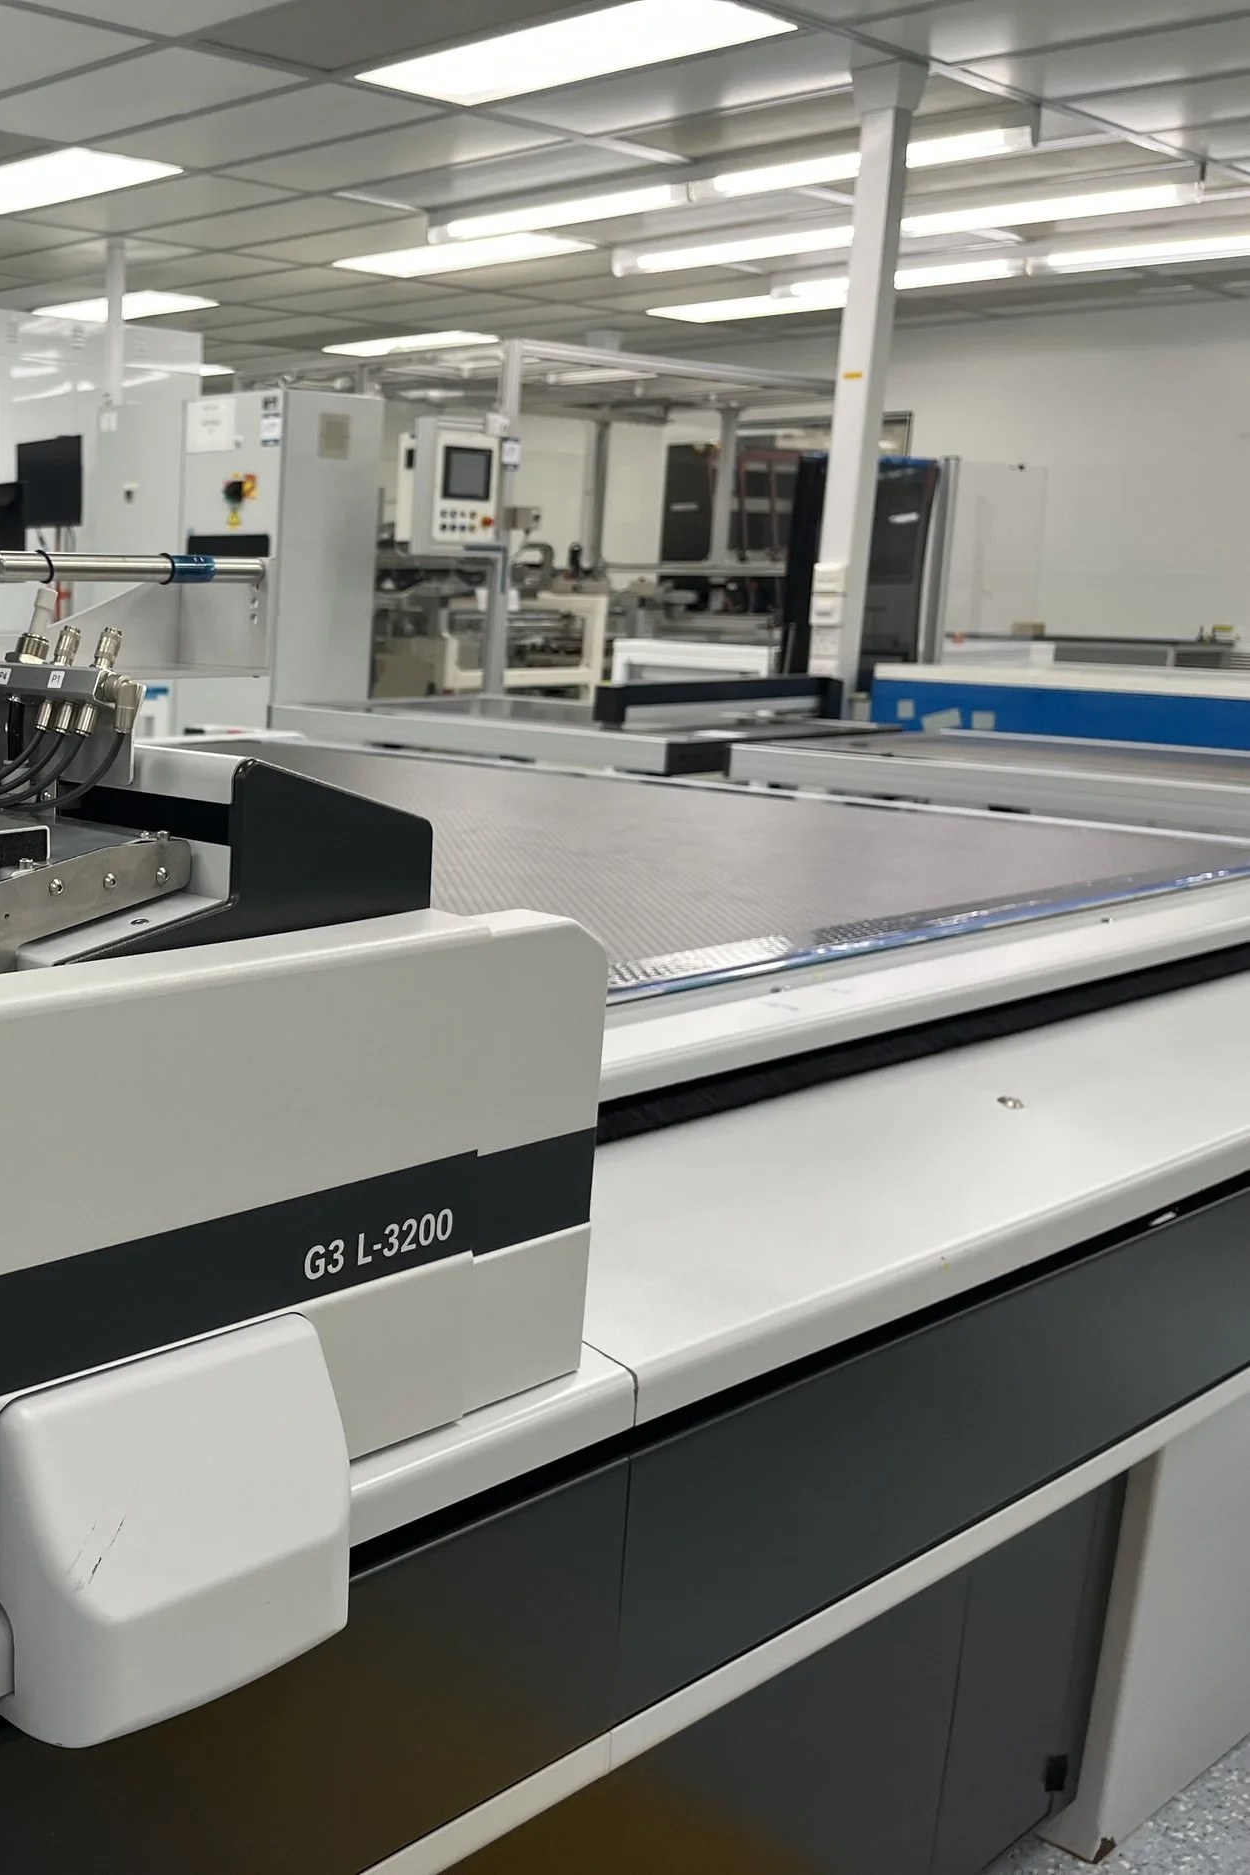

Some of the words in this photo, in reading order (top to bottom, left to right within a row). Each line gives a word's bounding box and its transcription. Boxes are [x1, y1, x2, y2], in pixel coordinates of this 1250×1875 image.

[51, 674, 61, 684] P1
[304, 1238, 345, 1280] G3
[357, 1208, 453, 1266] L-3200
